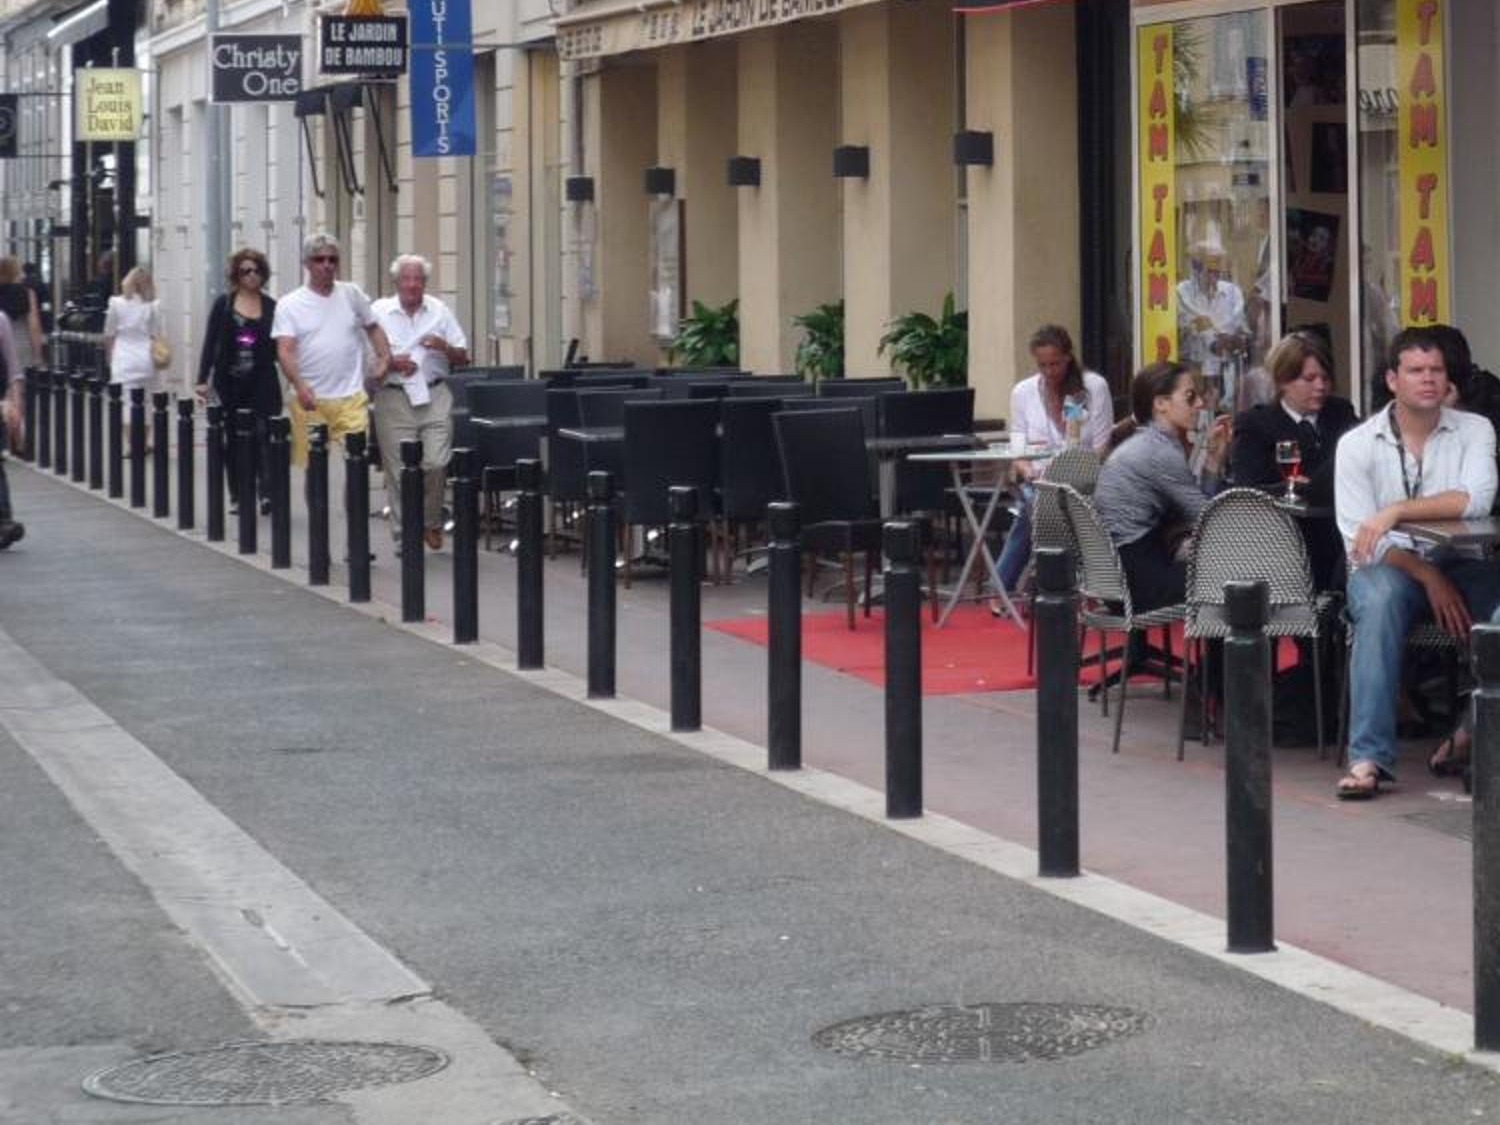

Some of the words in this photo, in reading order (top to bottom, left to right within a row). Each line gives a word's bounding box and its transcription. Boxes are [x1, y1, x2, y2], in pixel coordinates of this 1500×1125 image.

[330, 22, 345, 42] LE
[349, 22, 397, 42] JARDIN
[213, 43, 299, 76] Christy
[324, 46, 341, 66] DE
[345, 46, 403, 67] BAMBOU
[86, 77, 124, 94] Jean
[242, 71, 299, 96] One
[87, 96, 132, 114] Louis
[87, 114, 134, 132] David
